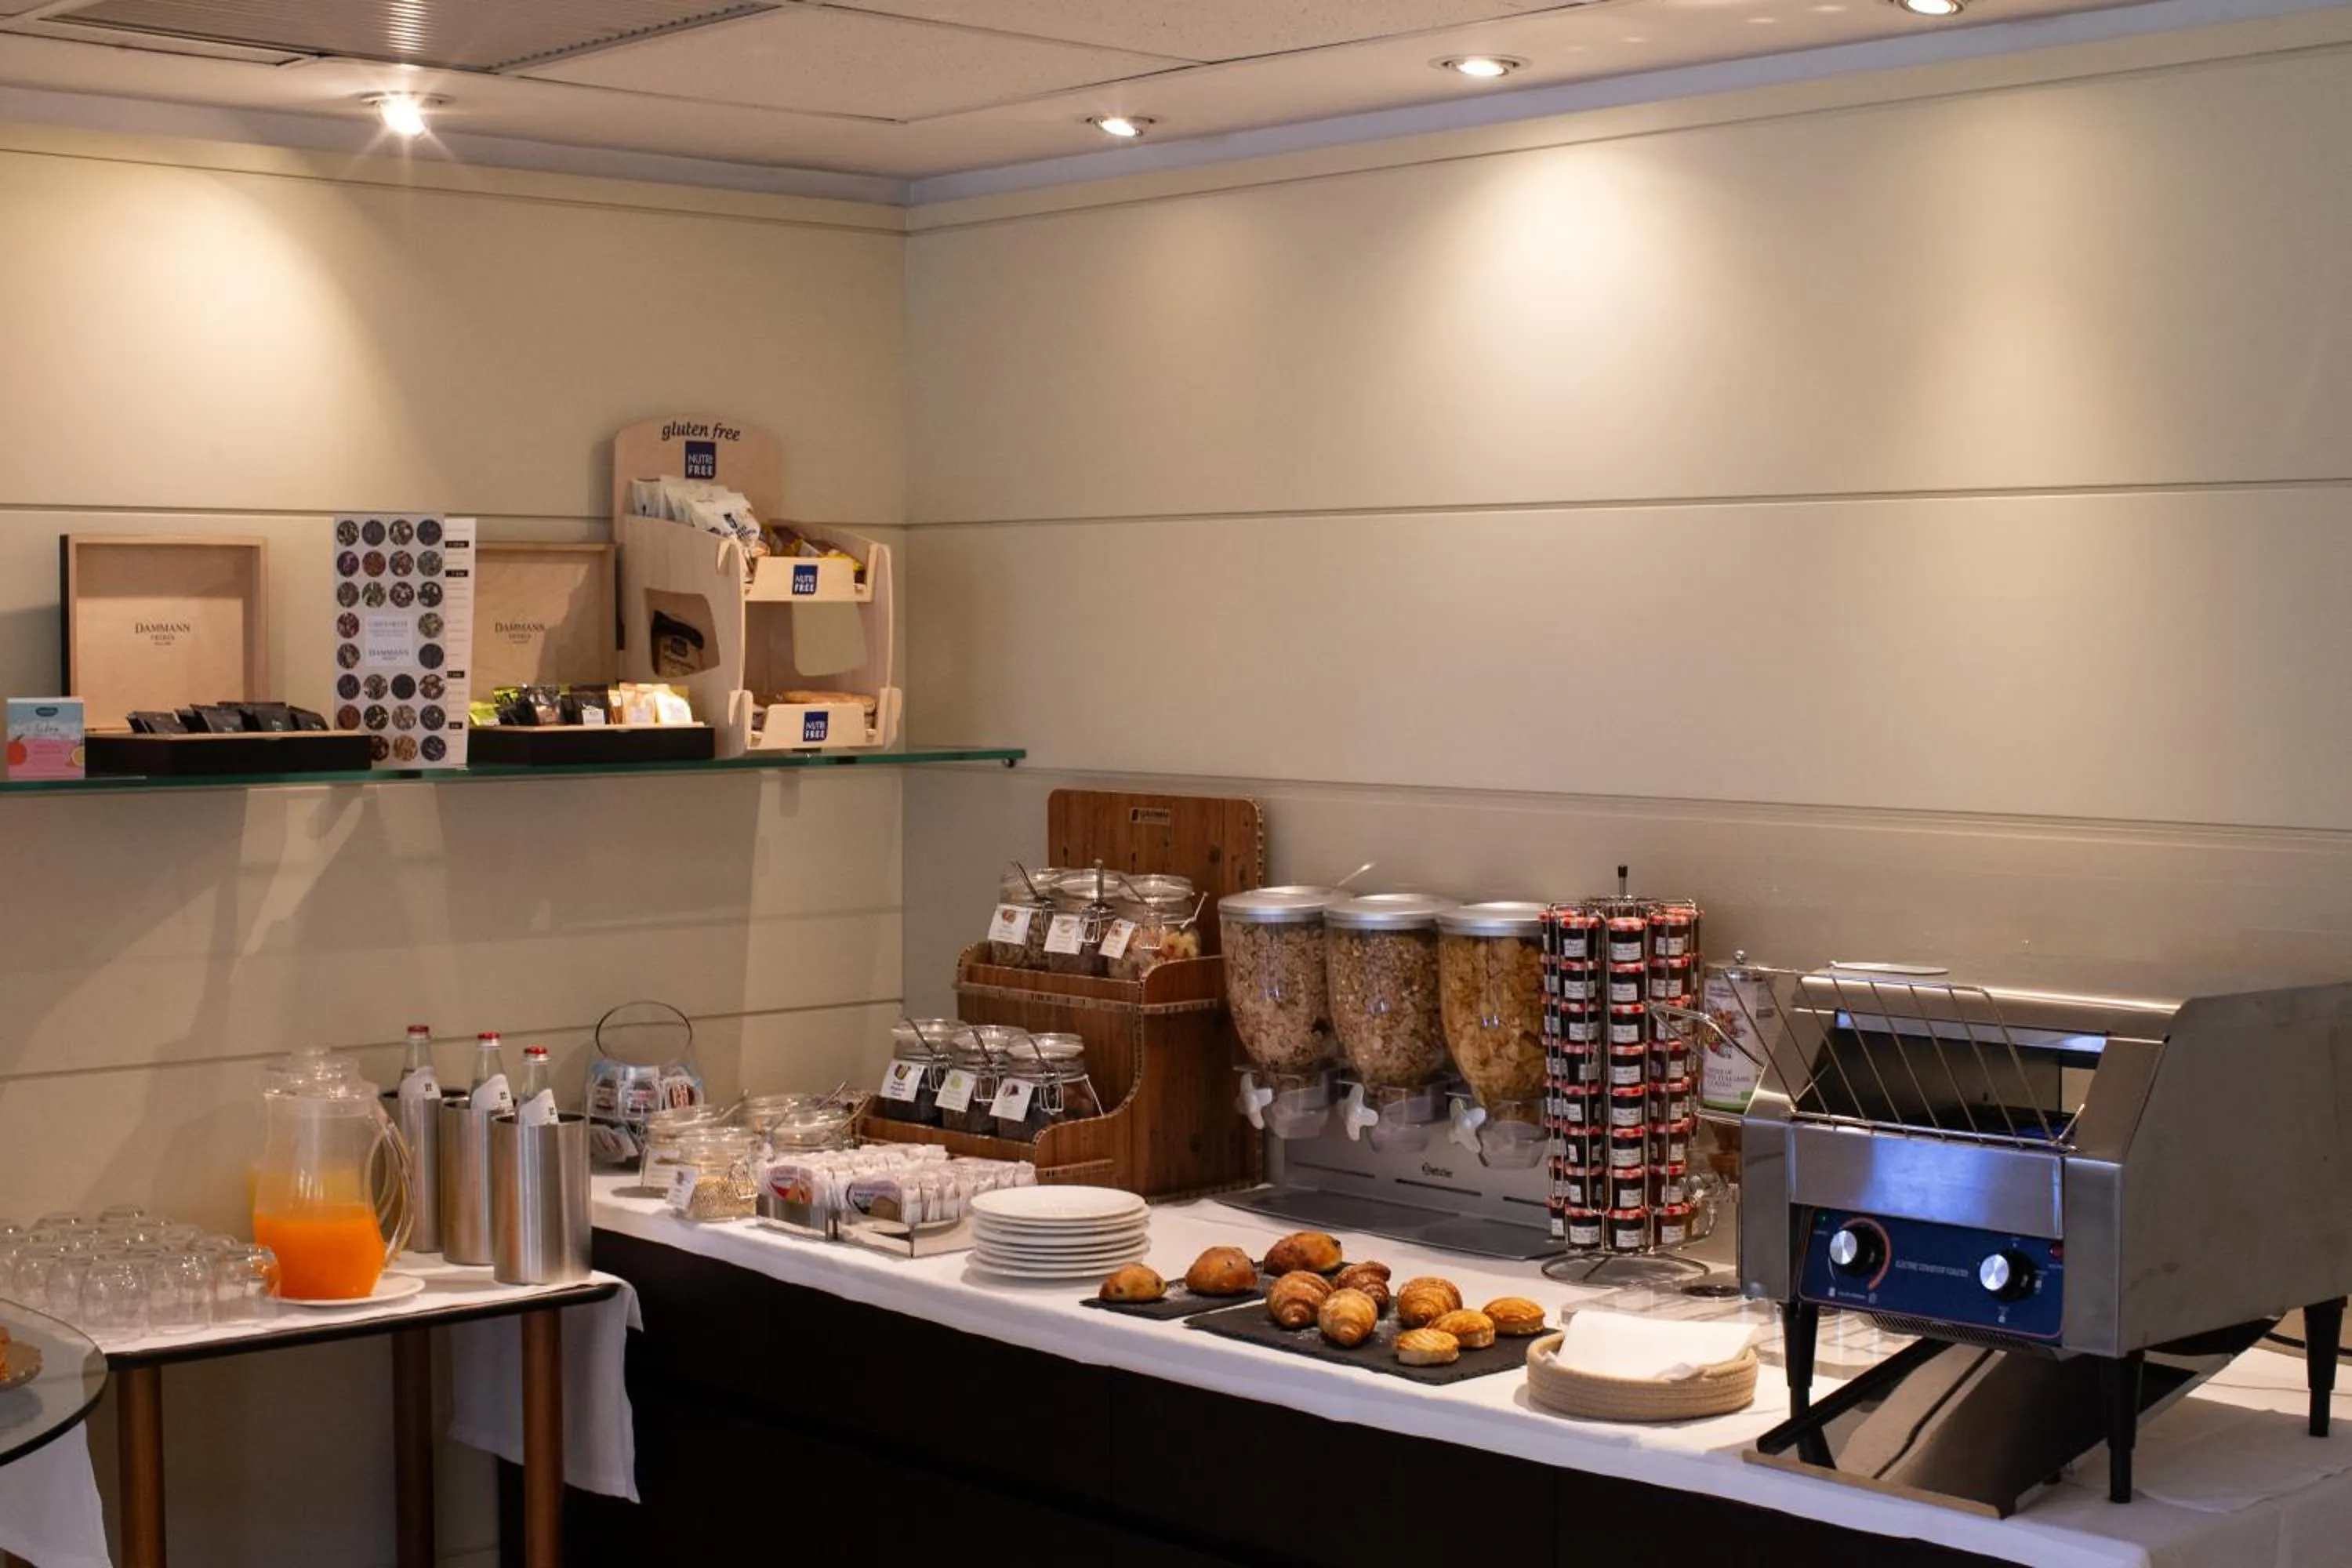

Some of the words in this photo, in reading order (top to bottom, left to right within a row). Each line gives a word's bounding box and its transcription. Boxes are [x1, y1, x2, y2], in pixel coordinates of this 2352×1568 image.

[661, 421, 709, 441] gluten
[710, 423, 741, 441] free
[688, 465, 713, 477] FREE
[794, 583, 815, 593] FREE
[135, 622, 191, 634] DAMMANN
[805, 730, 826, 739] FREE
